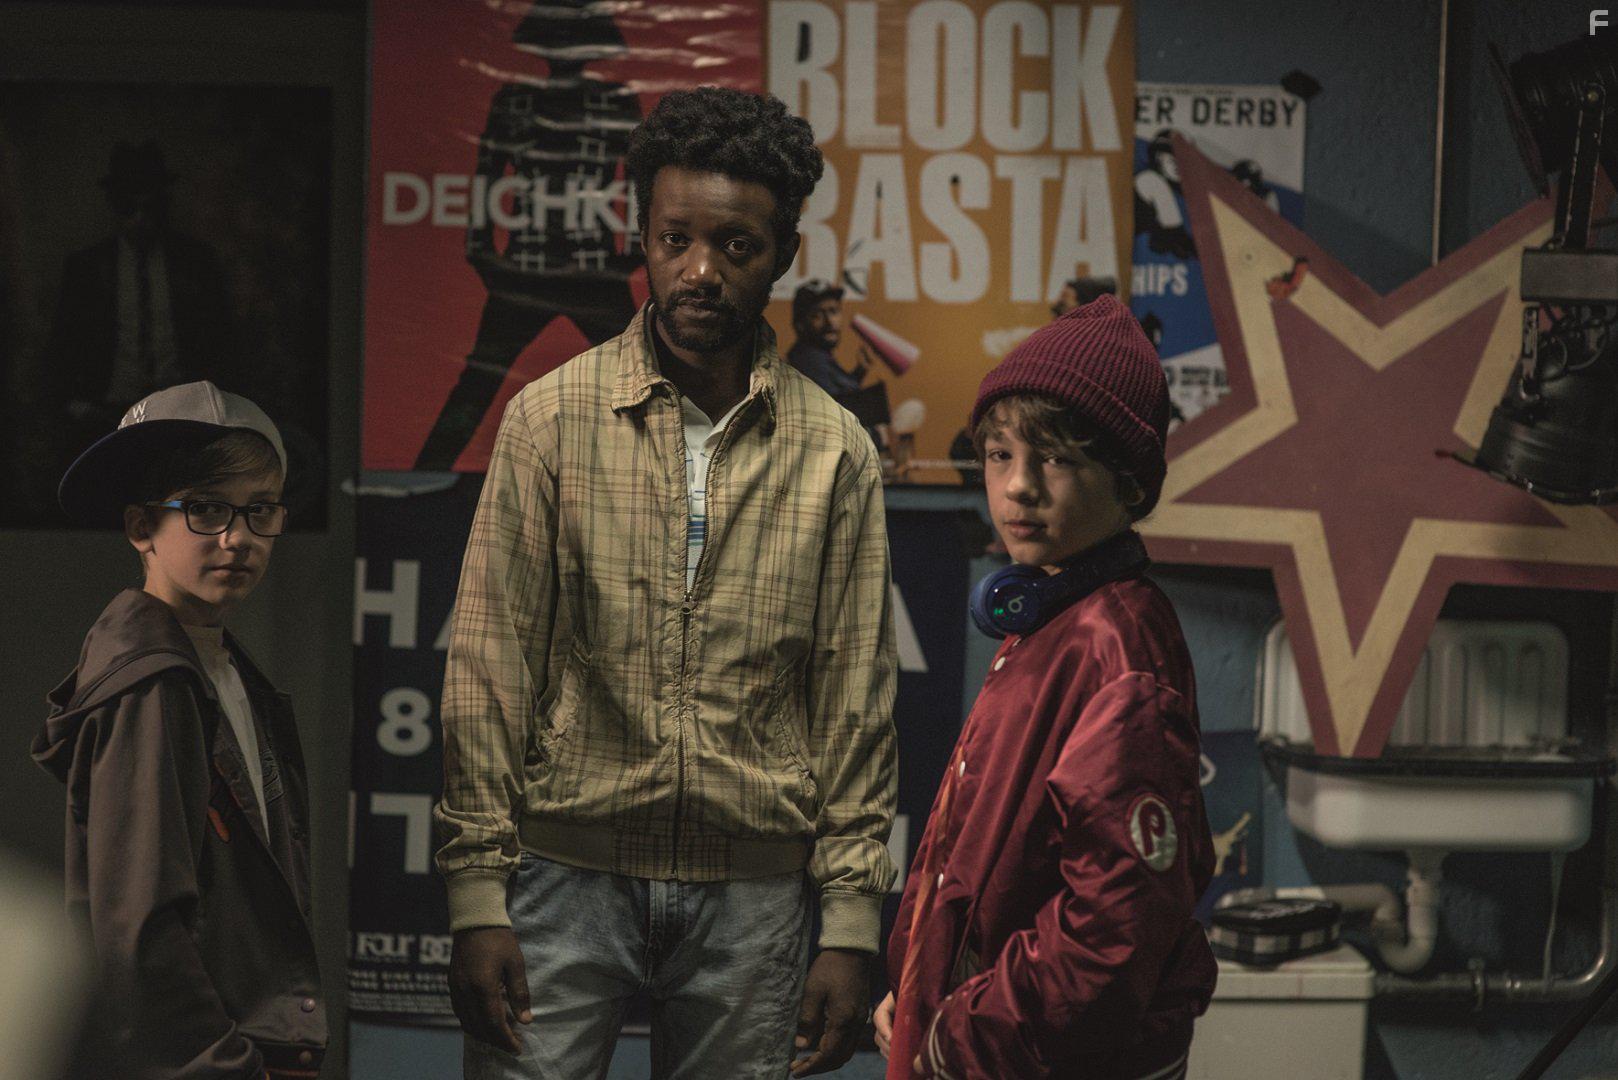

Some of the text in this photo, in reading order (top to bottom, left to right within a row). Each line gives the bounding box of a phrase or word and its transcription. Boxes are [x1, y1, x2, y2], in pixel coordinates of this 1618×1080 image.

[767, 0, 1123, 151] BLOCK
[1192, 97, 1298, 127] DERBY
[376, 686, 433, 757] 8
